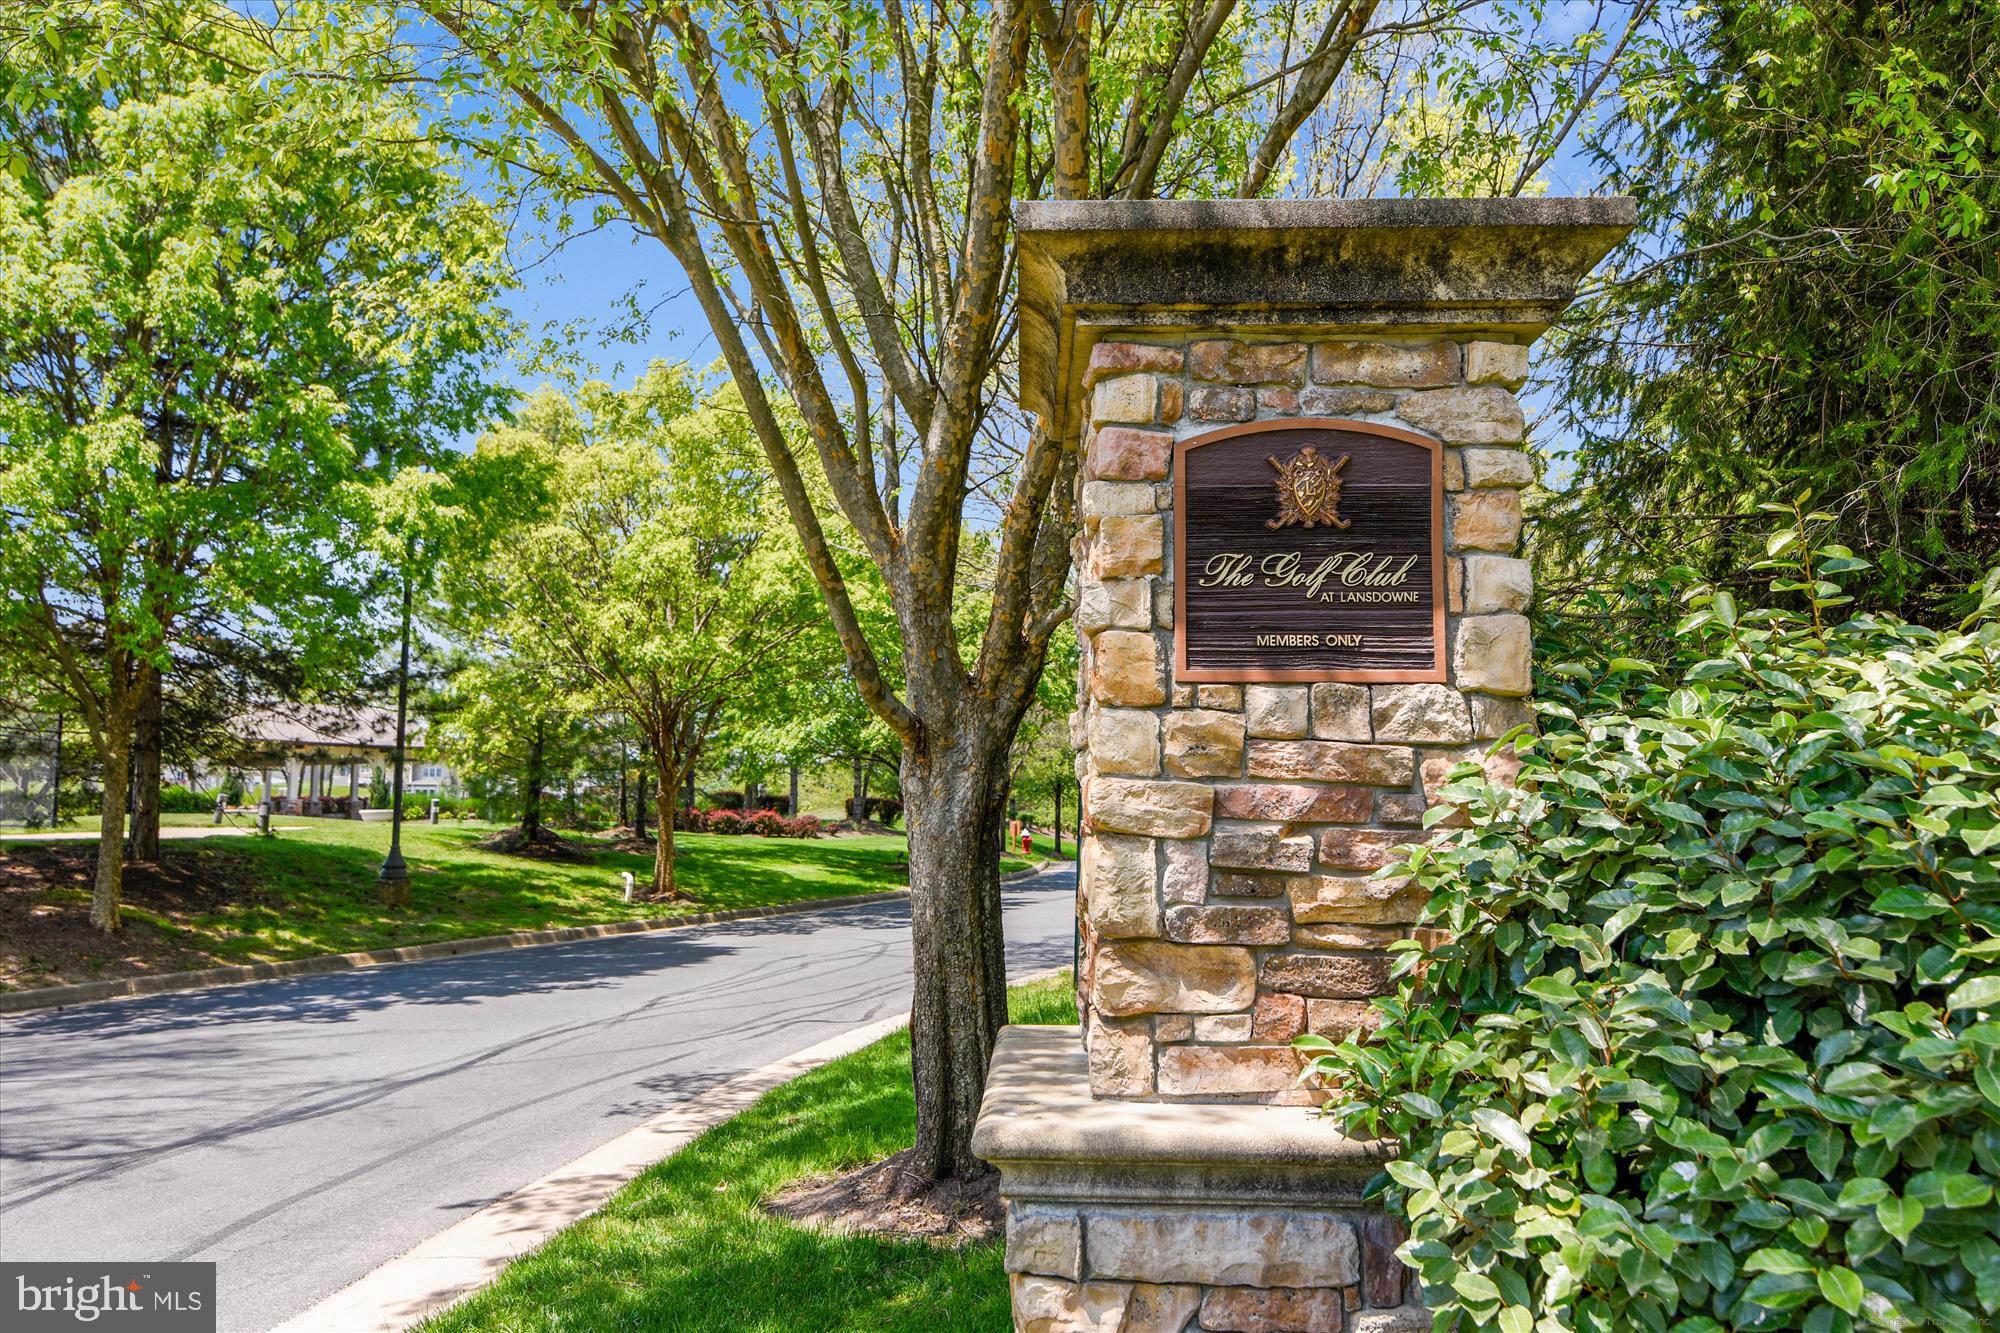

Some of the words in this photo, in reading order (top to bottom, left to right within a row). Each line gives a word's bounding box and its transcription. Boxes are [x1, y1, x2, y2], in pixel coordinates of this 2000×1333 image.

[1199, 553, 1254, 588] The
[1261, 551, 1337, 598] Golf
[1329, 552, 1419, 588] Club
[1320, 591, 1335, 603] AT
[1340, 591, 1419, 603] LANSDOWNE
[1256, 635, 1320, 647] MEMBERS
[1325, 635, 1363, 647] ONLY
